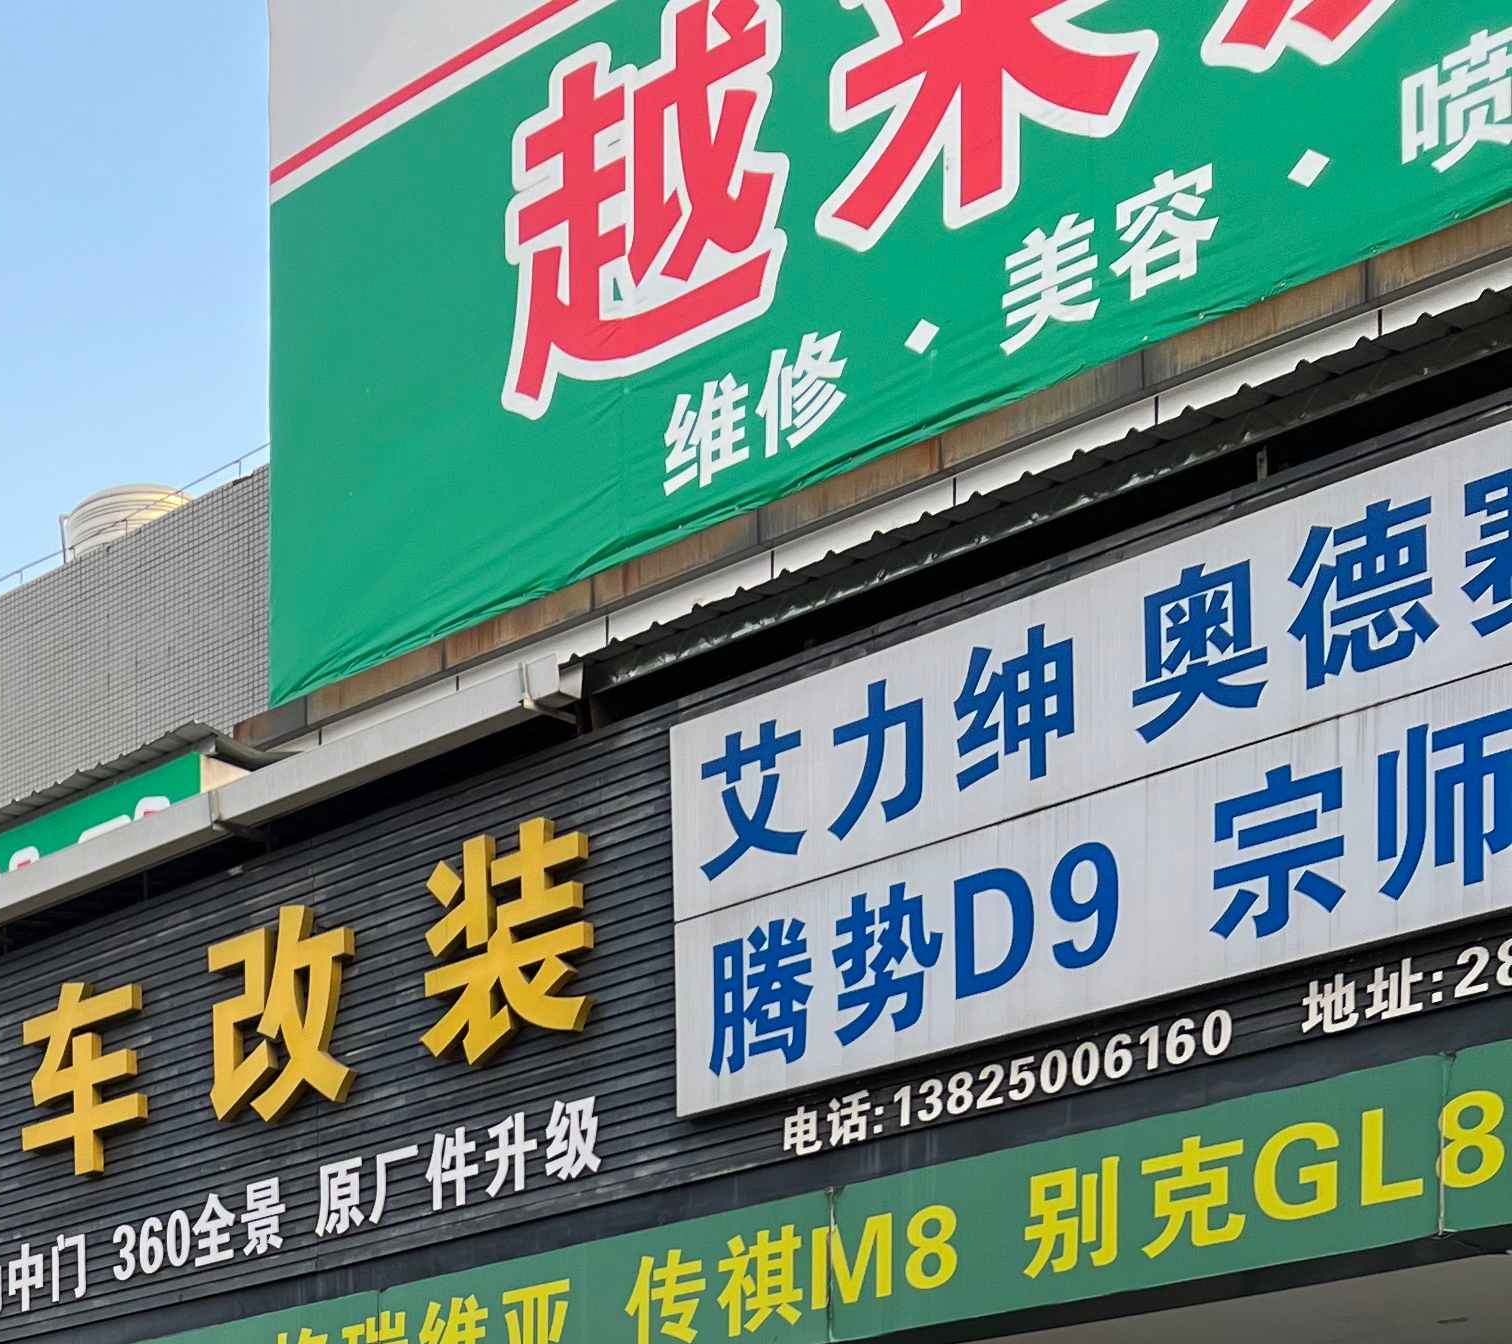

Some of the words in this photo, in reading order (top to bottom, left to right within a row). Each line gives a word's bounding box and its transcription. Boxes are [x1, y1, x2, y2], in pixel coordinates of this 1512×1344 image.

[502, 0, 1392, 420] 越来
[662, 330, 848, 497] 维修
[999, 163, 1219, 356] 美容
[700, 623, 1077, 882] 艾力绅
[707, 840, 1120, 1078] 腾势D9
[1210, 708, 1512, 940] 宗师
[112, 1176, 286, 1282] 360全景
[314, 1096, 602, 1238] 原厂件升级
[782, 1008, 1234, 1158] 电话:13825006160
[1022, 1089, 1506, 1278] 别克GL8
